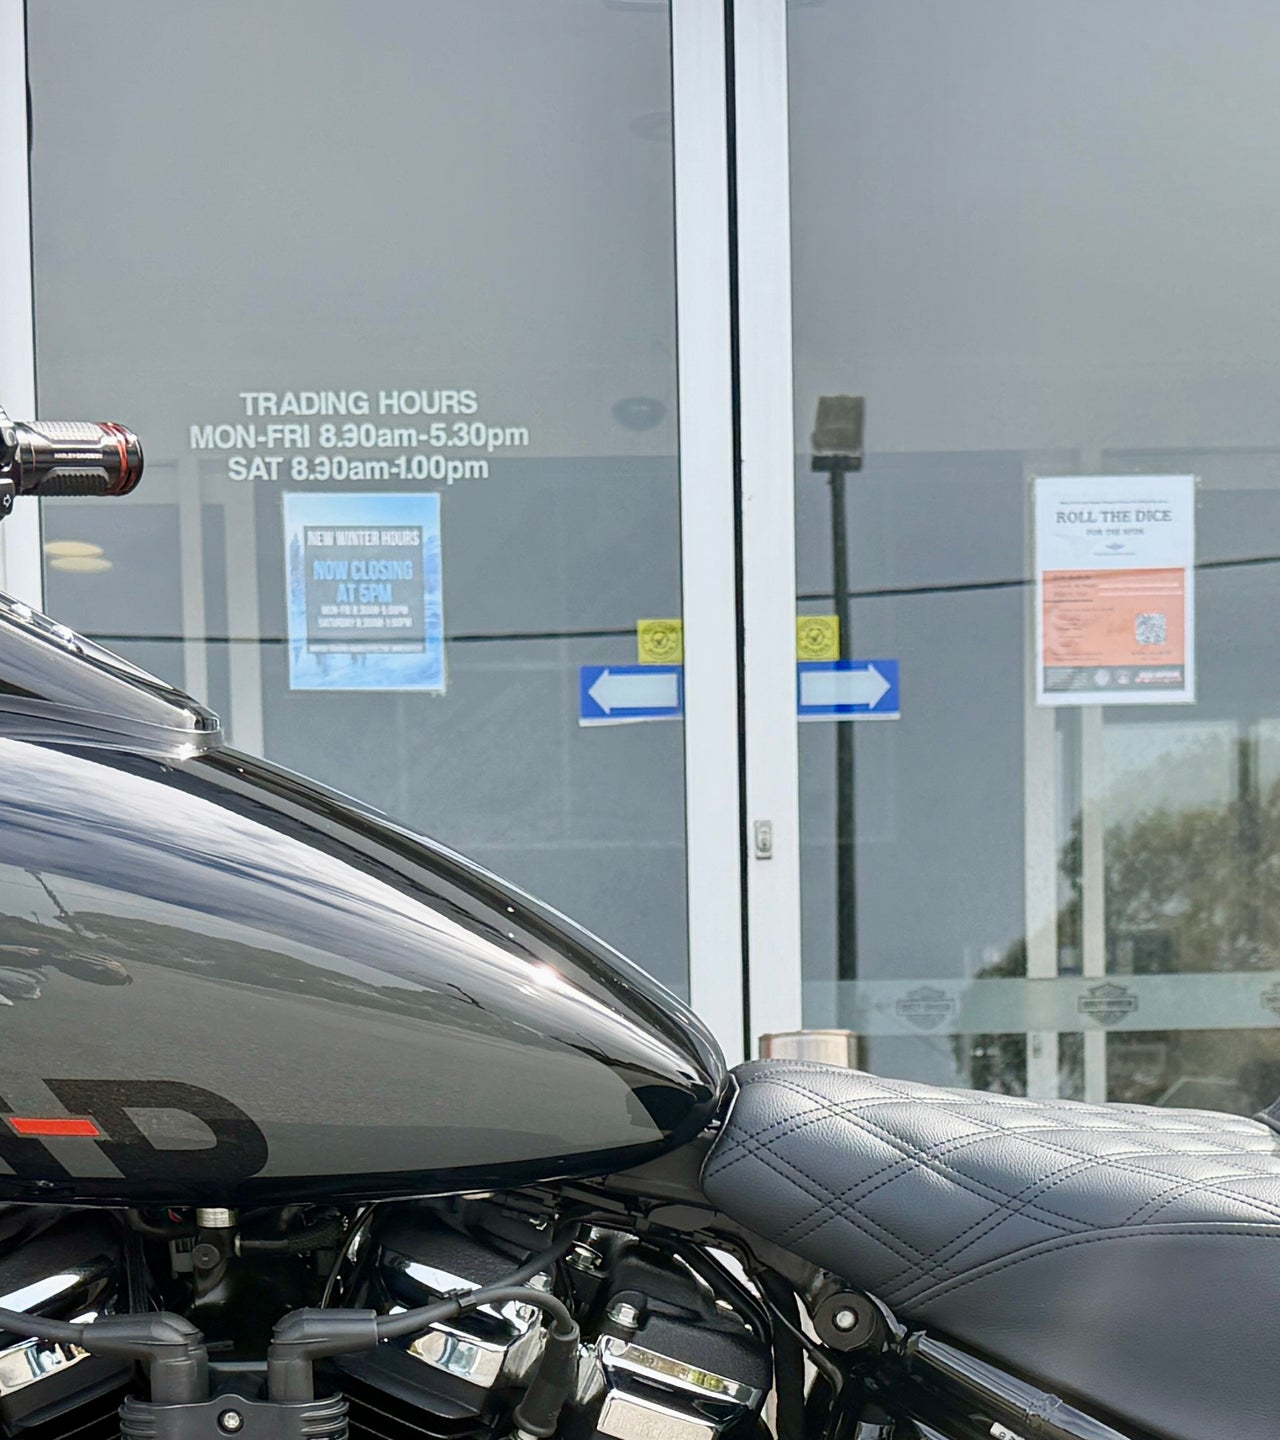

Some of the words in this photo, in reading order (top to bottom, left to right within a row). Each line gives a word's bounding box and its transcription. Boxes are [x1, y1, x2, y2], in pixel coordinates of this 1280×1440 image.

[240, 391, 370, 416] TRADING
[379, 390, 478, 415] HOURS
[189, 424, 311, 449] MON-FRI
[228, 456, 284, 482] SAT
[1056, 511, 1098, 524] ROLL
[1100, 510, 1132, 523] THE
[1135, 509, 1173, 522] DICE
[307, 530, 334, 546] NEW
[335, 530, 380, 546] WINTER
[381, 530, 420, 546] HOURS
[313, 560, 349, 580] NOW
[350, 560, 414, 580] CLOSING
[336, 583, 357, 603] AT
[359, 582, 393, 603] 5PM
